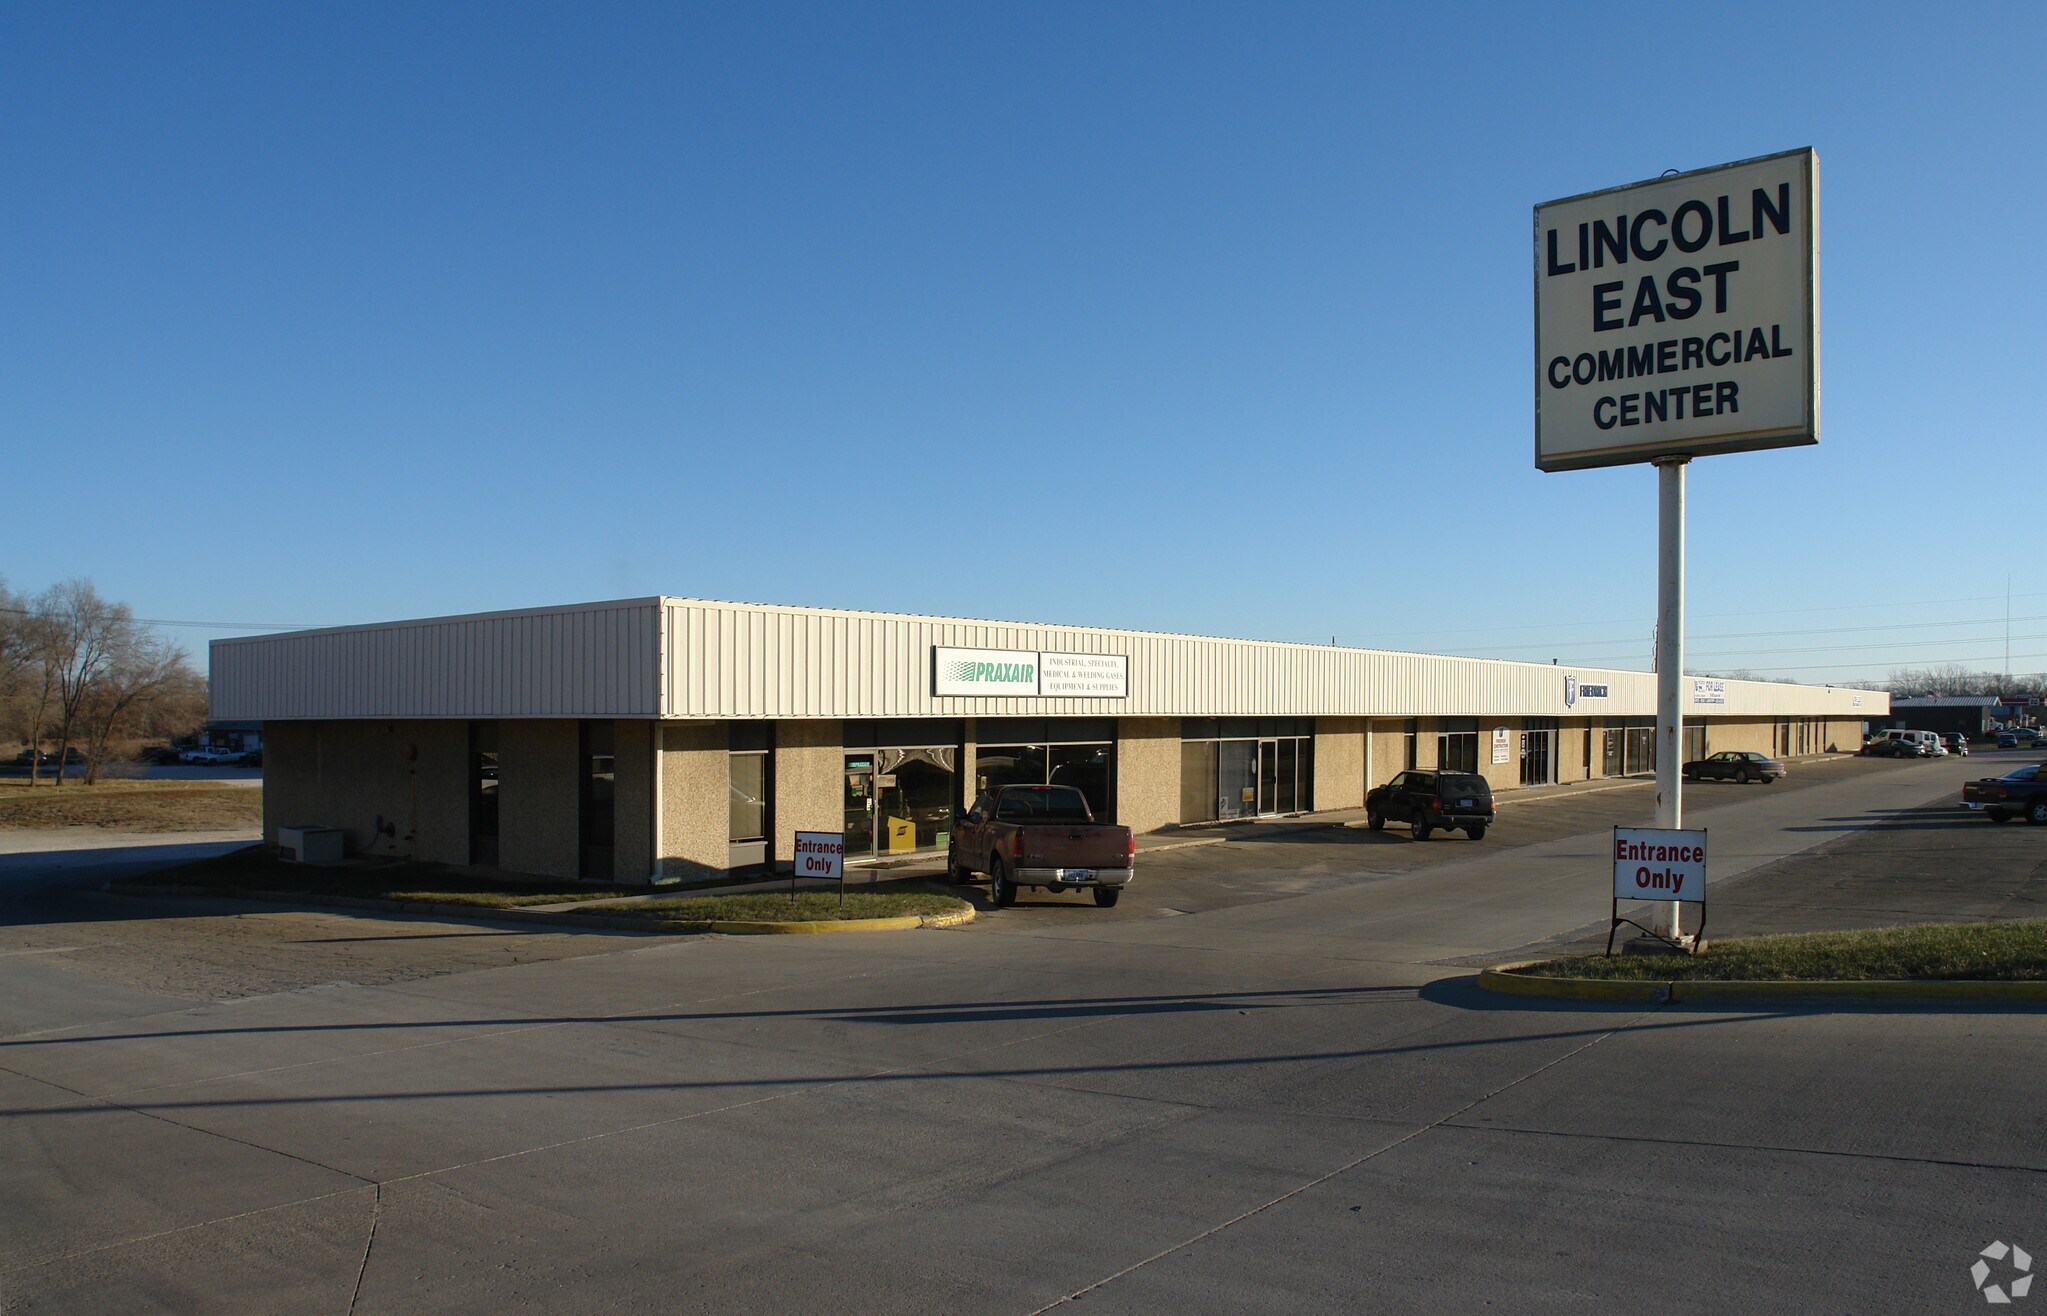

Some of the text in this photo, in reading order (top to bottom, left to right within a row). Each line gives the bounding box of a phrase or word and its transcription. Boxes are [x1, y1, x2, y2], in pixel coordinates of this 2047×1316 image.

[1547, 182, 1790, 277] LINCOLN
[1593, 260, 1739, 332] EAST
[1548, 324, 1793, 389] COMMERCIAL
[1593, 381, 1739, 430] CENTER
[976, 662, 1034, 683] PRAXAIR
[1043, 670, 1070, 678] MEDICAL
[1078, 671, 1105, 679] WELDING
[1049, 682, 1085, 691] EQUIPMENT
[1092, 683, 1119, 691] SUPPLIES
[796, 839, 843, 854] Entrance
[1616, 839, 1704, 863] Entrance
[806, 856, 832, 874] Only
[1635, 866, 1684, 894] Only
